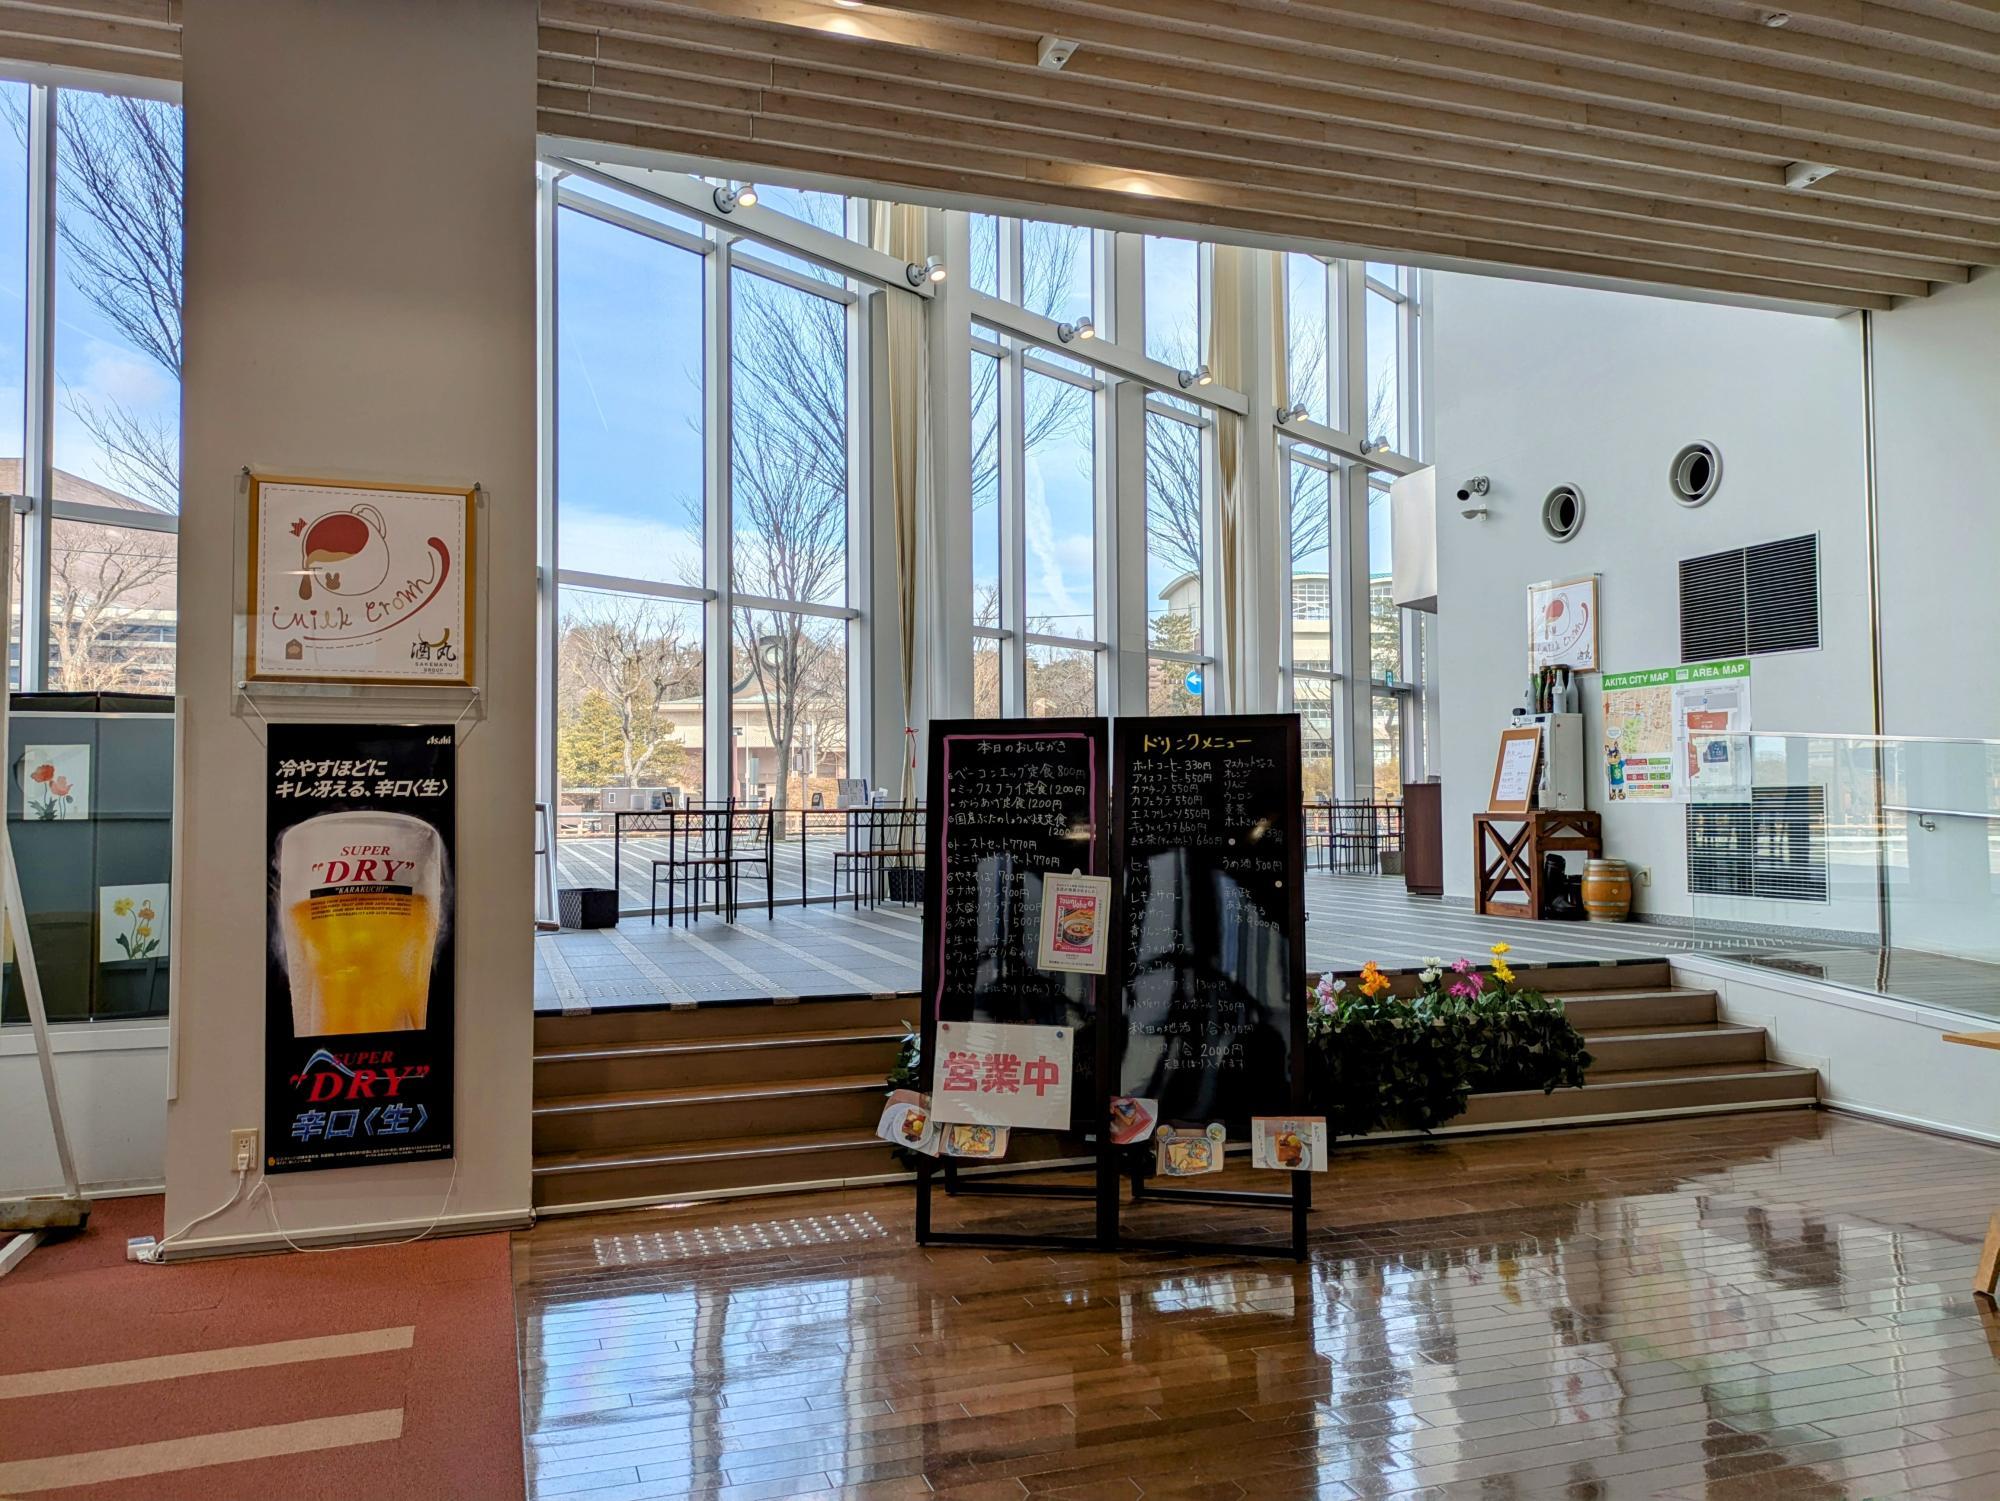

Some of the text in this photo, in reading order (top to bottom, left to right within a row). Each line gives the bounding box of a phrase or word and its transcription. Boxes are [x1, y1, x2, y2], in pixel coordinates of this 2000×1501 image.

[411, 641, 457, 661] 酒丸
[1692, 668, 1719, 678] AREA
[1722, 664, 1745, 674] MAP
[1604, 677, 1628, 688] AKITA
[1629, 674, 1649, 684] CITY
[1649, 672, 1669, 682] MAP
[426, 735, 451, 745] Asahi
[1143, 734, 1252, 755] ドリンクメニュー
[275, 759, 388, 778] 冷やすほどに
[341, 845, 391, 856] SUPER
[333, 1051, 395, 1065] SUPER
[943, 1051, 1060, 1097] 営業中
